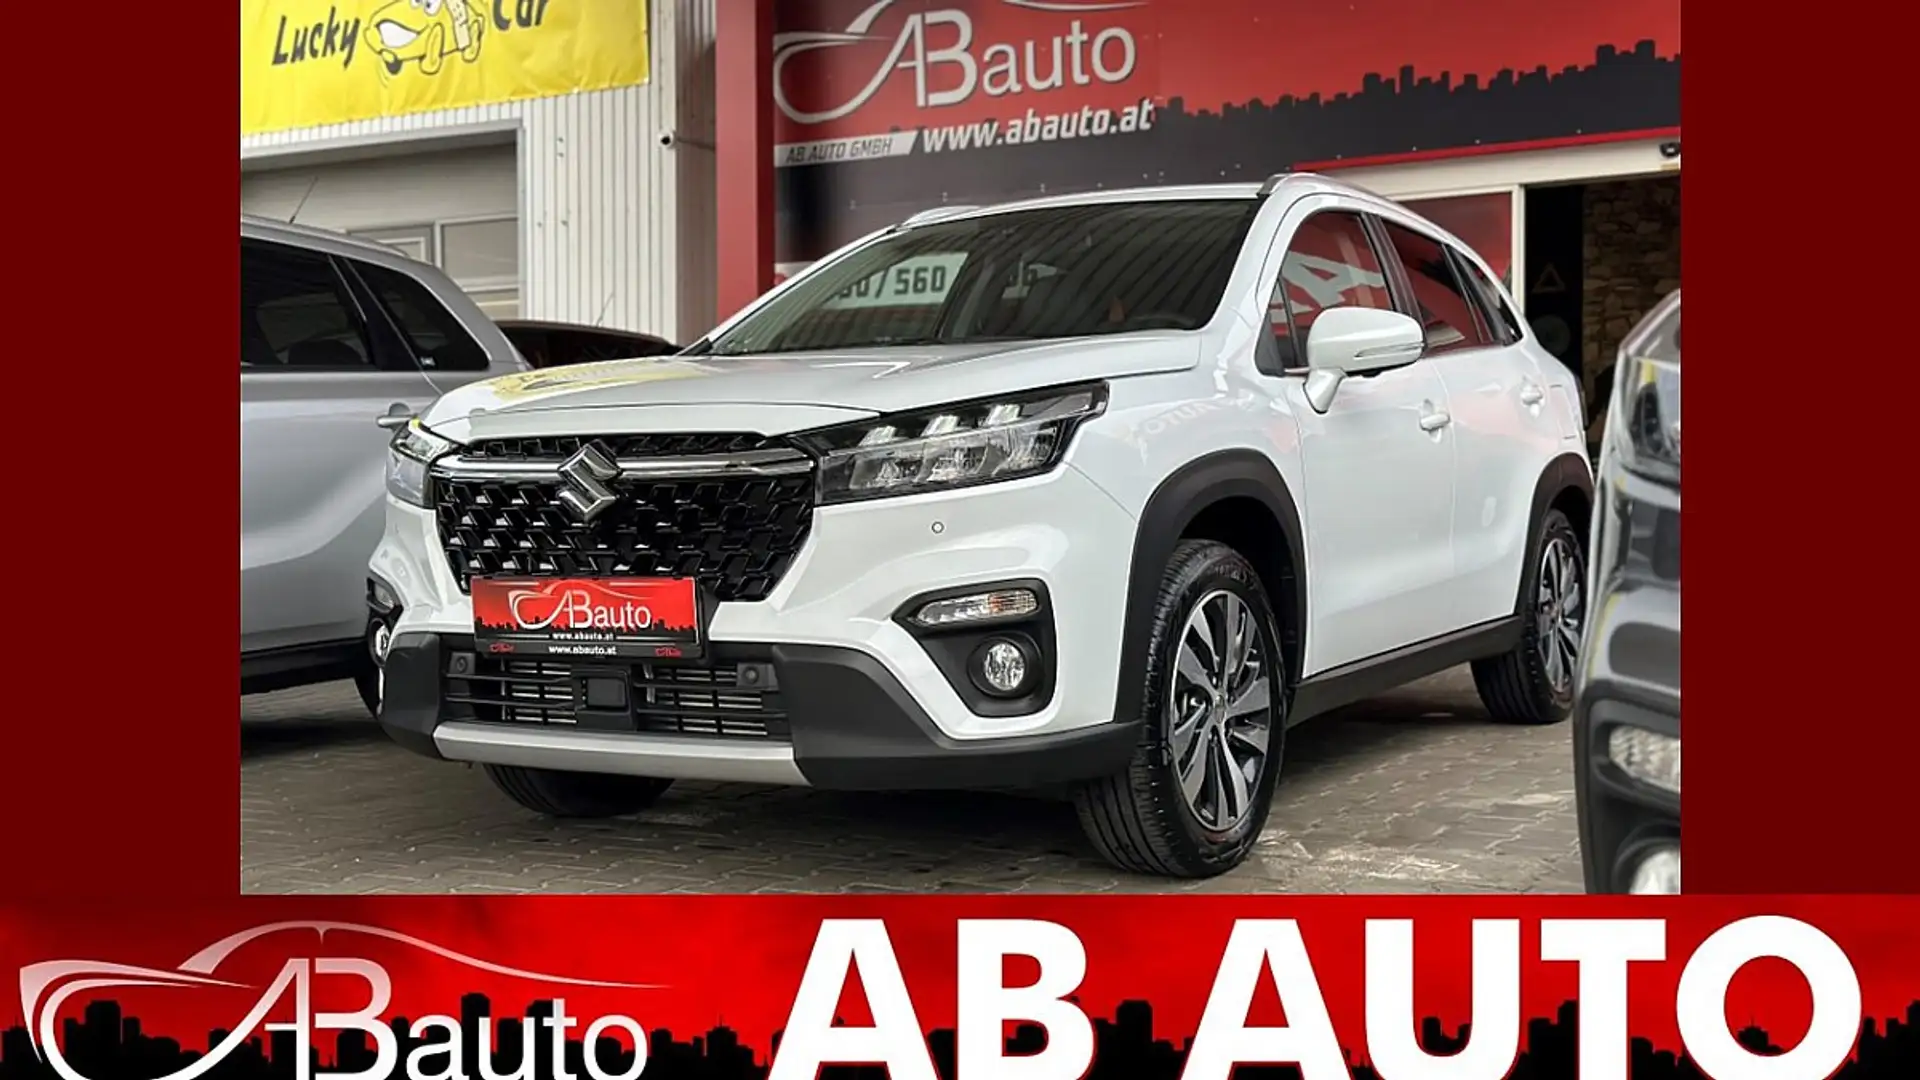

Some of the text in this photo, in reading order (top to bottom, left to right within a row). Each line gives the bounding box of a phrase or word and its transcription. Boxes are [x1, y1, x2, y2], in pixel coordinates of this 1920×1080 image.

[272, 6, 359, 70] Lucky
[923, 98, 1153, 153] www.abauto.at
[786, 138, 893, 163] AB AUTO GMBH
[548, 645, 617, 656] www.abauto.at
